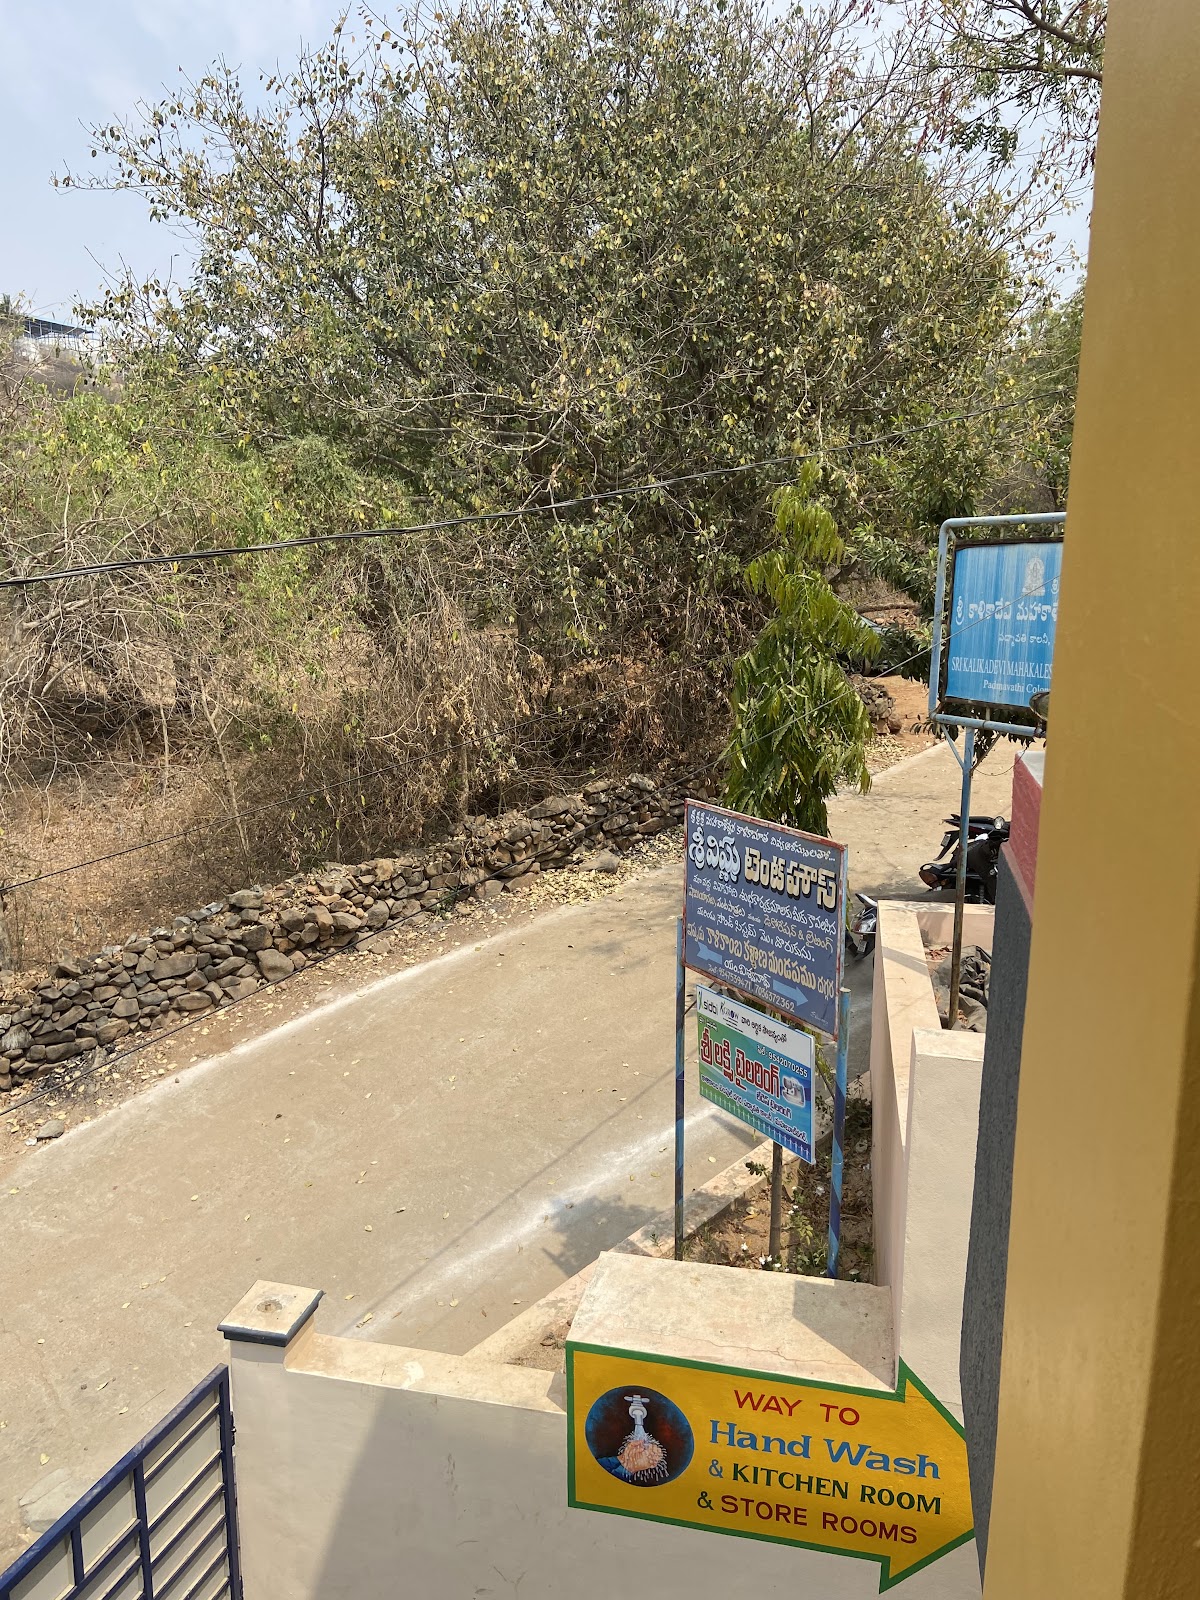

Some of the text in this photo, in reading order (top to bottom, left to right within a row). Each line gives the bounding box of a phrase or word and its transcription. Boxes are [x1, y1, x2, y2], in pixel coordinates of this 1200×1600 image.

[983, 680, 1025, 693] Padmavathi
[733, 1389, 861, 1426] WAY TO
[708, 1419, 942, 1480] Hand Wash
[708, 1459, 942, 1515] & KITCHEN ROOM
[696, 1491, 918, 1545] & STORE ROOMS
